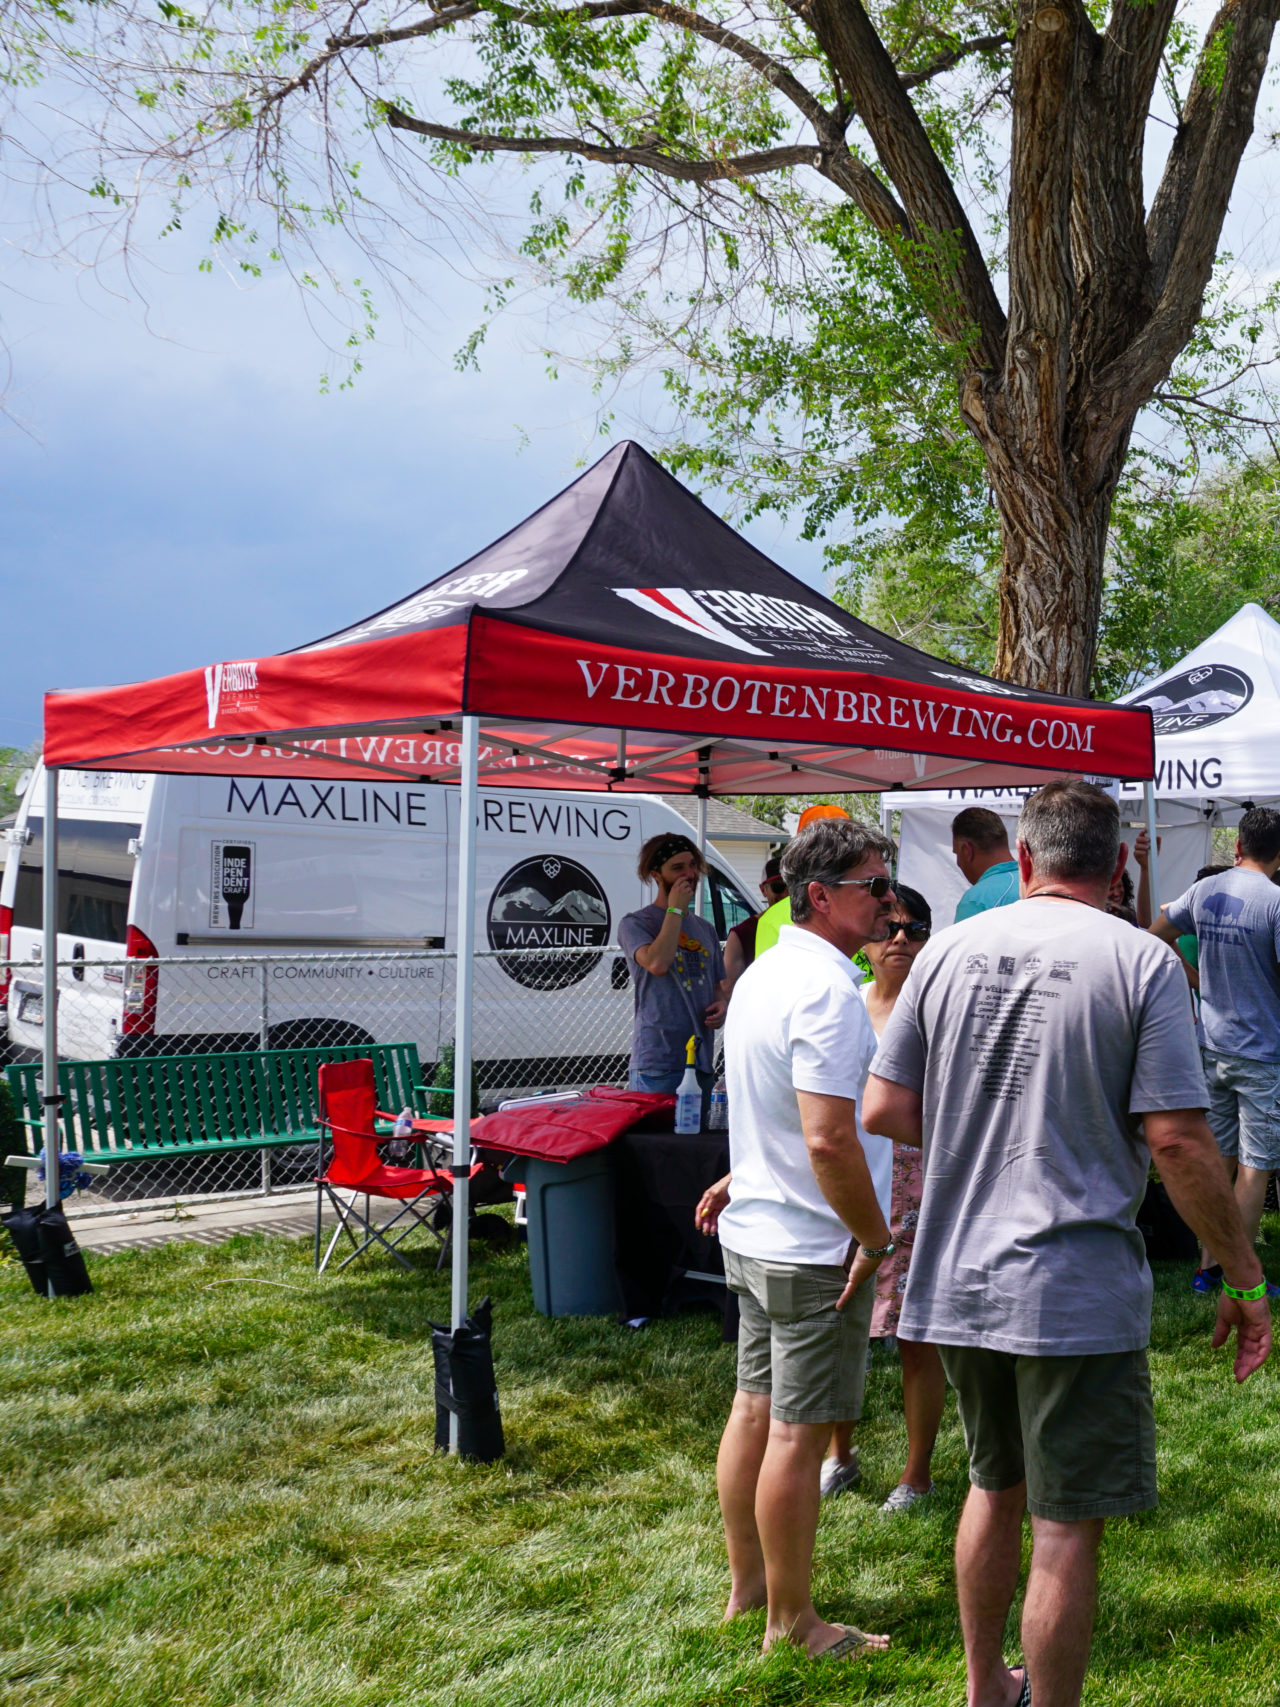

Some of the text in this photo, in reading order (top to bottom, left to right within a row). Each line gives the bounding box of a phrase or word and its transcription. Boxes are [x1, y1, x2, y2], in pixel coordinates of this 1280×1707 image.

[576, 659, 1095, 754] VERBOTENBREWING.COM
[227, 778, 631, 841] MAXLINE REWING
[224, 858, 247, 868] INDE
[223, 868, 243, 877] PEN
[212, 845, 221, 925] BREWERS ASSOCIATION
[223, 878, 249, 887] DENT
[505, 927, 594, 946] MAXLINE
[207, 966, 434, 980] CRAFT COMMUNITY CULTURE
